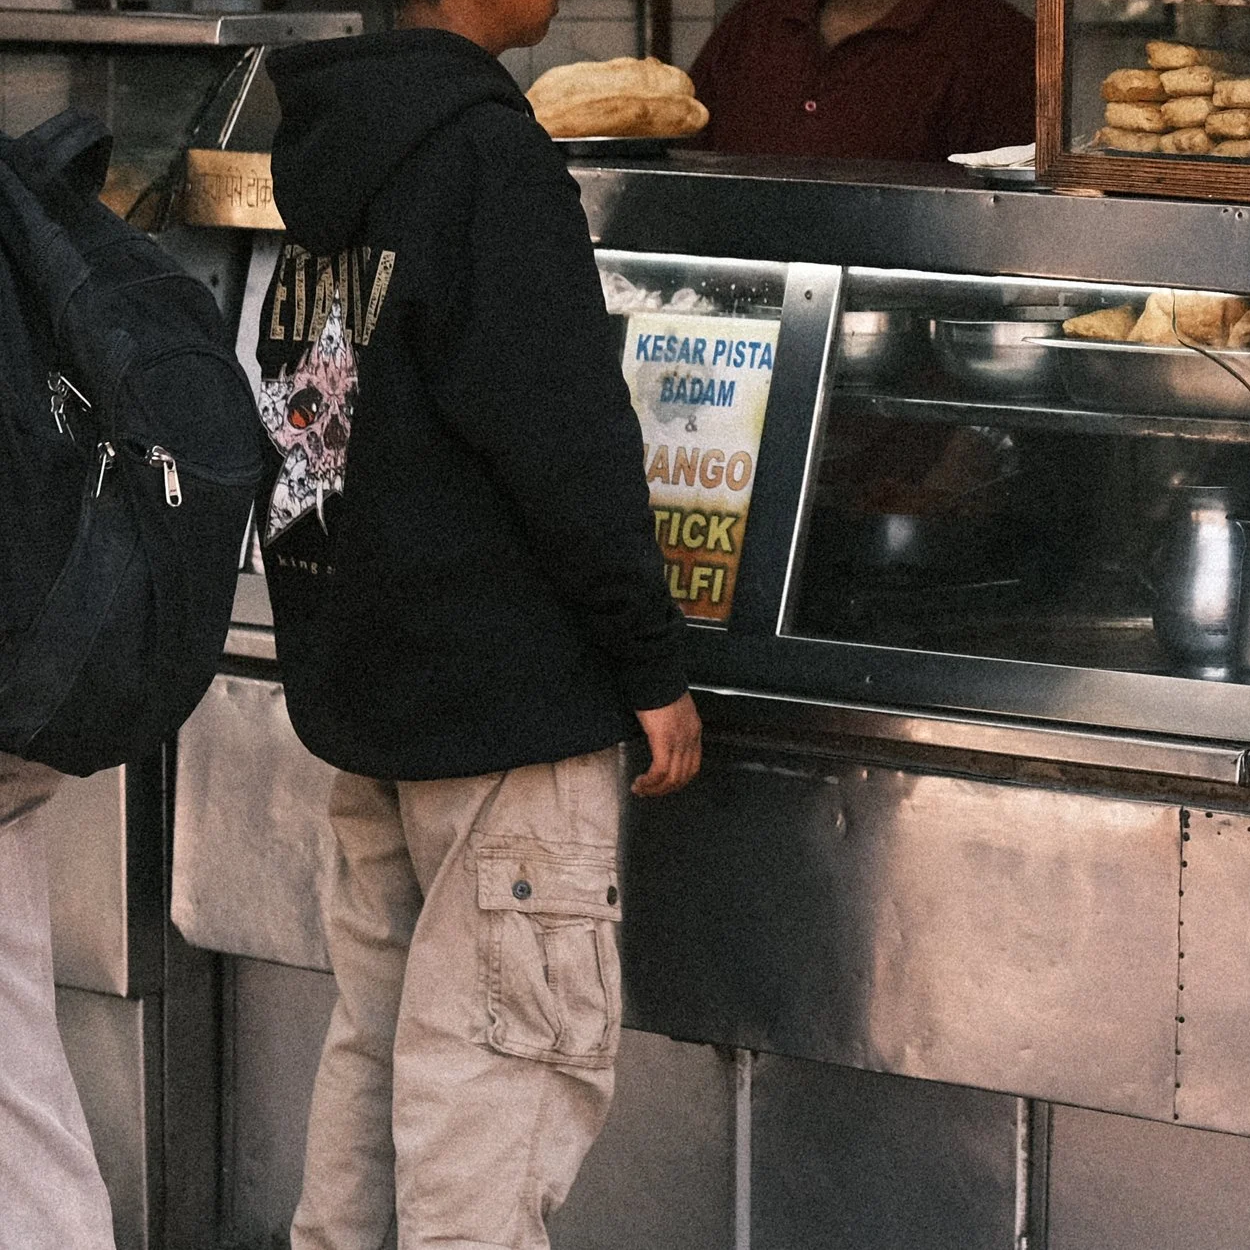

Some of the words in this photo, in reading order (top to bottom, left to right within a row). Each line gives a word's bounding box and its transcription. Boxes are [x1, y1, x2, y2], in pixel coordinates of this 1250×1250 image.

[635, 333, 705, 364] KESAR
[712, 339, 774, 371] PISTA
[660, 377, 736, 409] BADAM
[684, 415, 698, 433] &
[643, 443, 753, 492] ANGO
[654, 508, 737, 553] TICK
[664, 564, 725, 604] LFI
